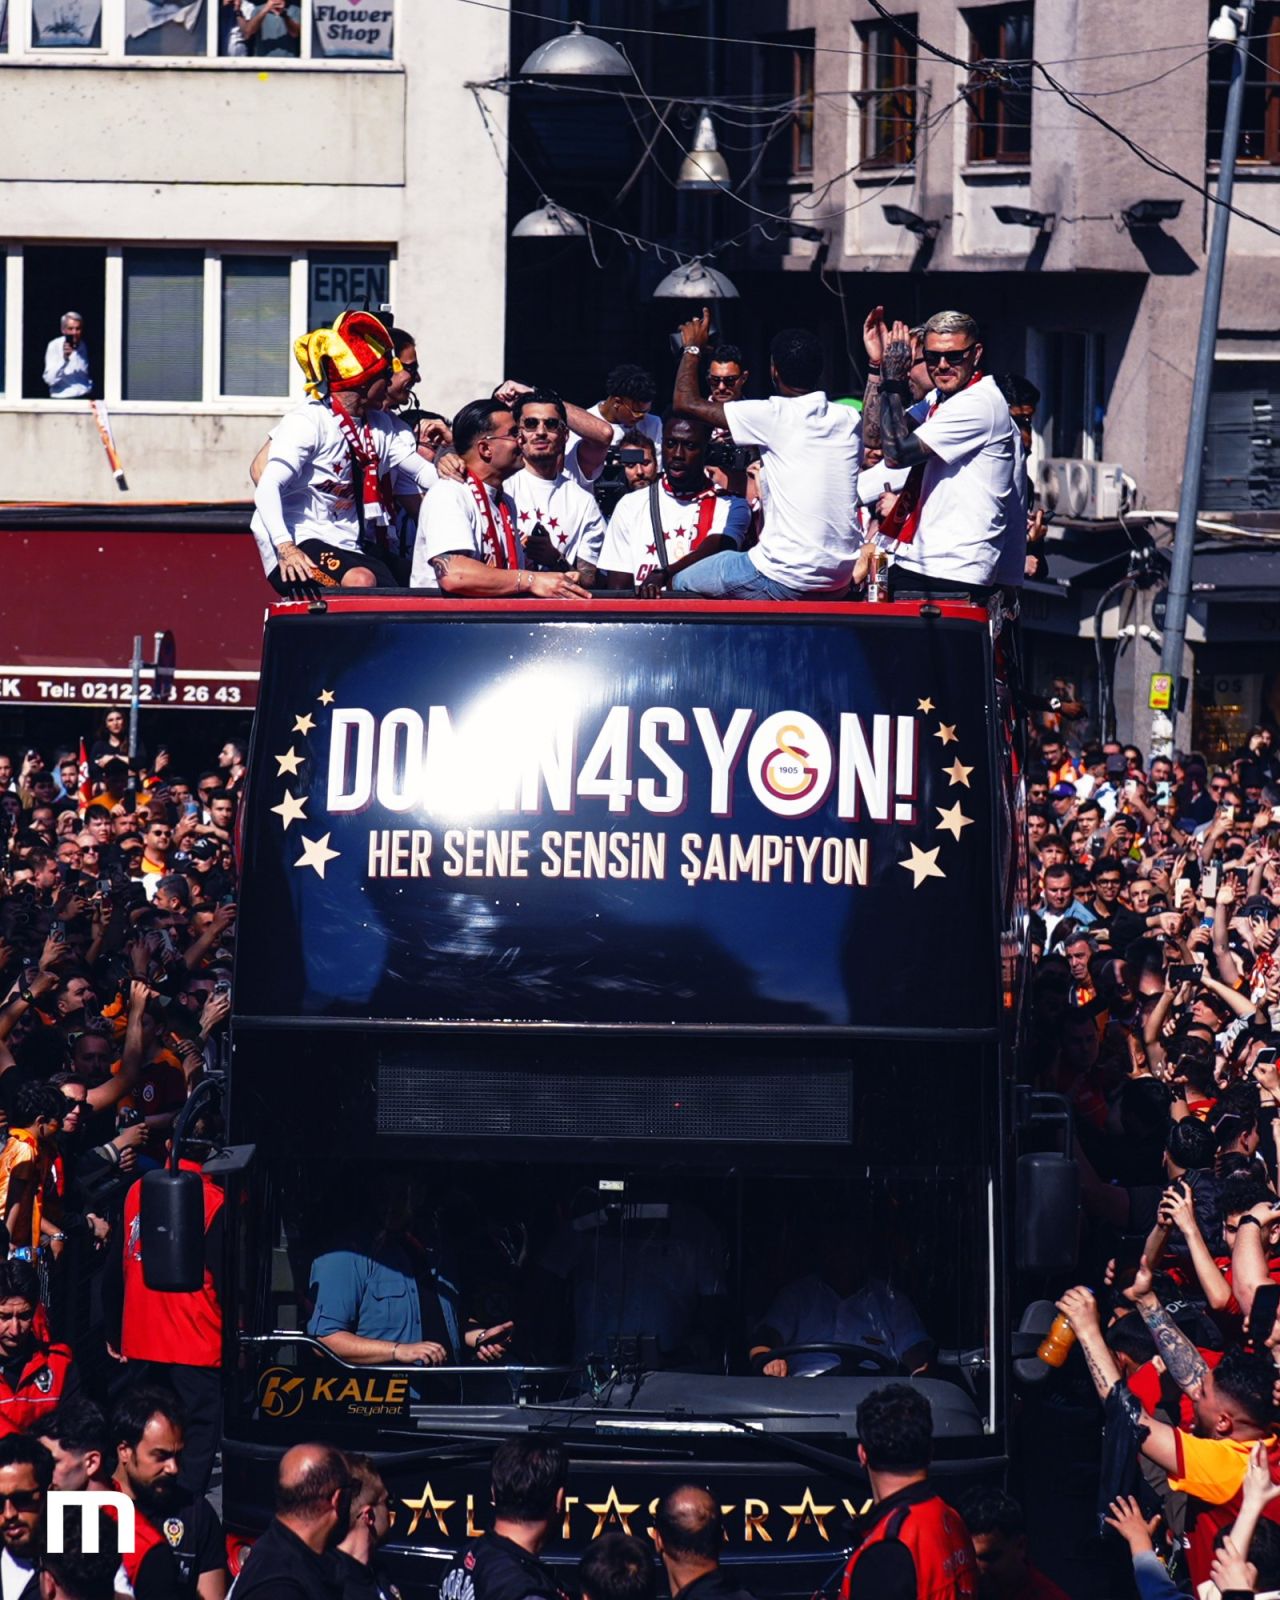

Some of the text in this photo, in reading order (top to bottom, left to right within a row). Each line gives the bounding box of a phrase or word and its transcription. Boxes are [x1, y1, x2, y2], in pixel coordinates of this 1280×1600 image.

[316, 5, 392, 22] Flower
[327, 24, 380, 44] Shop
[314, 267, 386, 302] EREN
[0, 678, 241, 702] K Tel: 0212 23 26 43
[327, 705, 918, 824] DON4SYON!
[779, 766, 799, 774] 1905
[367, 830, 433, 879] HER
[442, 830, 530, 879] SENE
[312, 1377, 408, 1402] KALE
[347, 1404, 402, 1416] Seyahat
